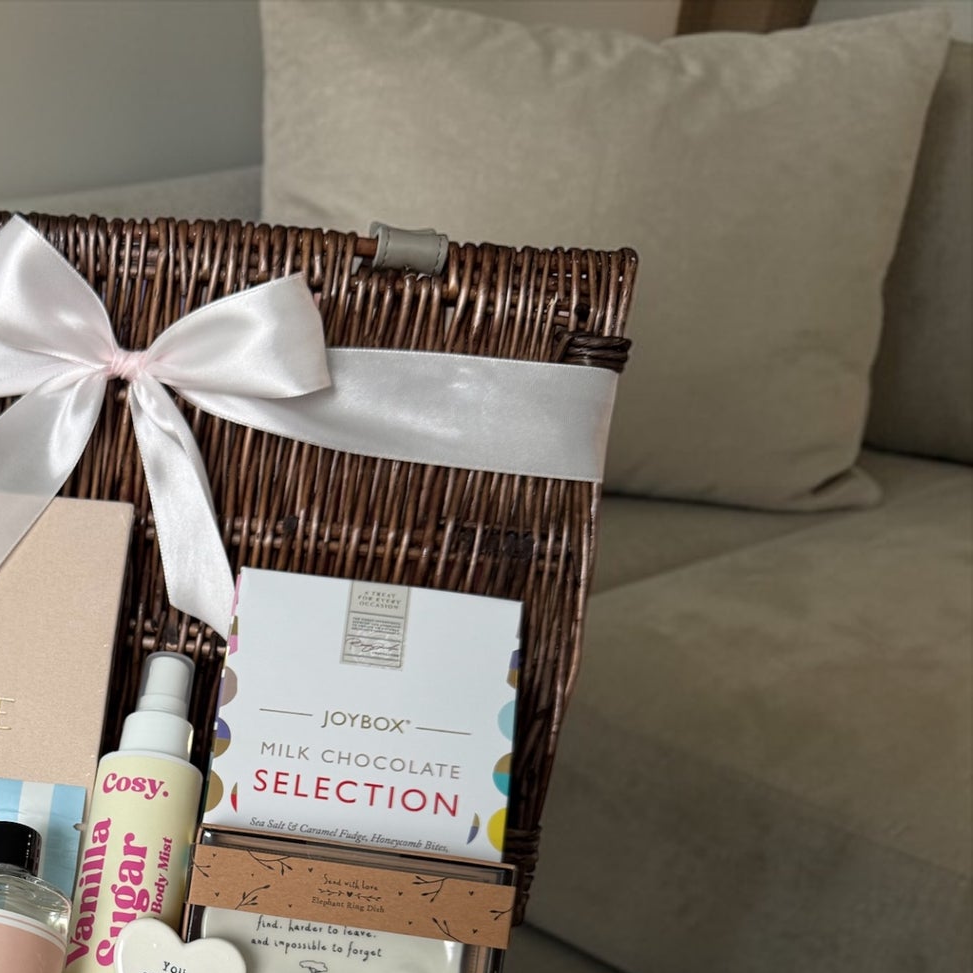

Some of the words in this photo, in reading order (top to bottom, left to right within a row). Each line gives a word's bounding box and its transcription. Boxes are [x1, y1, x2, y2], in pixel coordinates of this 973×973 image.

[260, 742, 310, 761] MILK
[321, 749, 461, 780] CHOCOLATE
[253, 769, 459, 817] SELECTION
[250, 817, 265, 827] Sea
[267, 819, 285, 830] Salt
[287, 822, 298, 832] &
[300, 824, 338, 837] Caramel
[339, 829, 368, 843] Fudge,
[371, 834, 422, 848] Honeycomb
[158, 837, 173, 871] Mist
[65, 817, 112, 968] Vanilla
[151, 874, 169, 914] Body
[344, 879, 360, 890] with
[311, 897, 344, 908] Elephant
[347, 900, 364, 912] Ring
[366, 904, 385, 913] Dish
[289, 919, 323, 933] harder
[328, 925, 339, 935] to
[251, 937, 270, 946] and
[274, 939, 327, 955] impossible
[332, 944, 343, 953] to
[347, 941, 382, 961] forget
